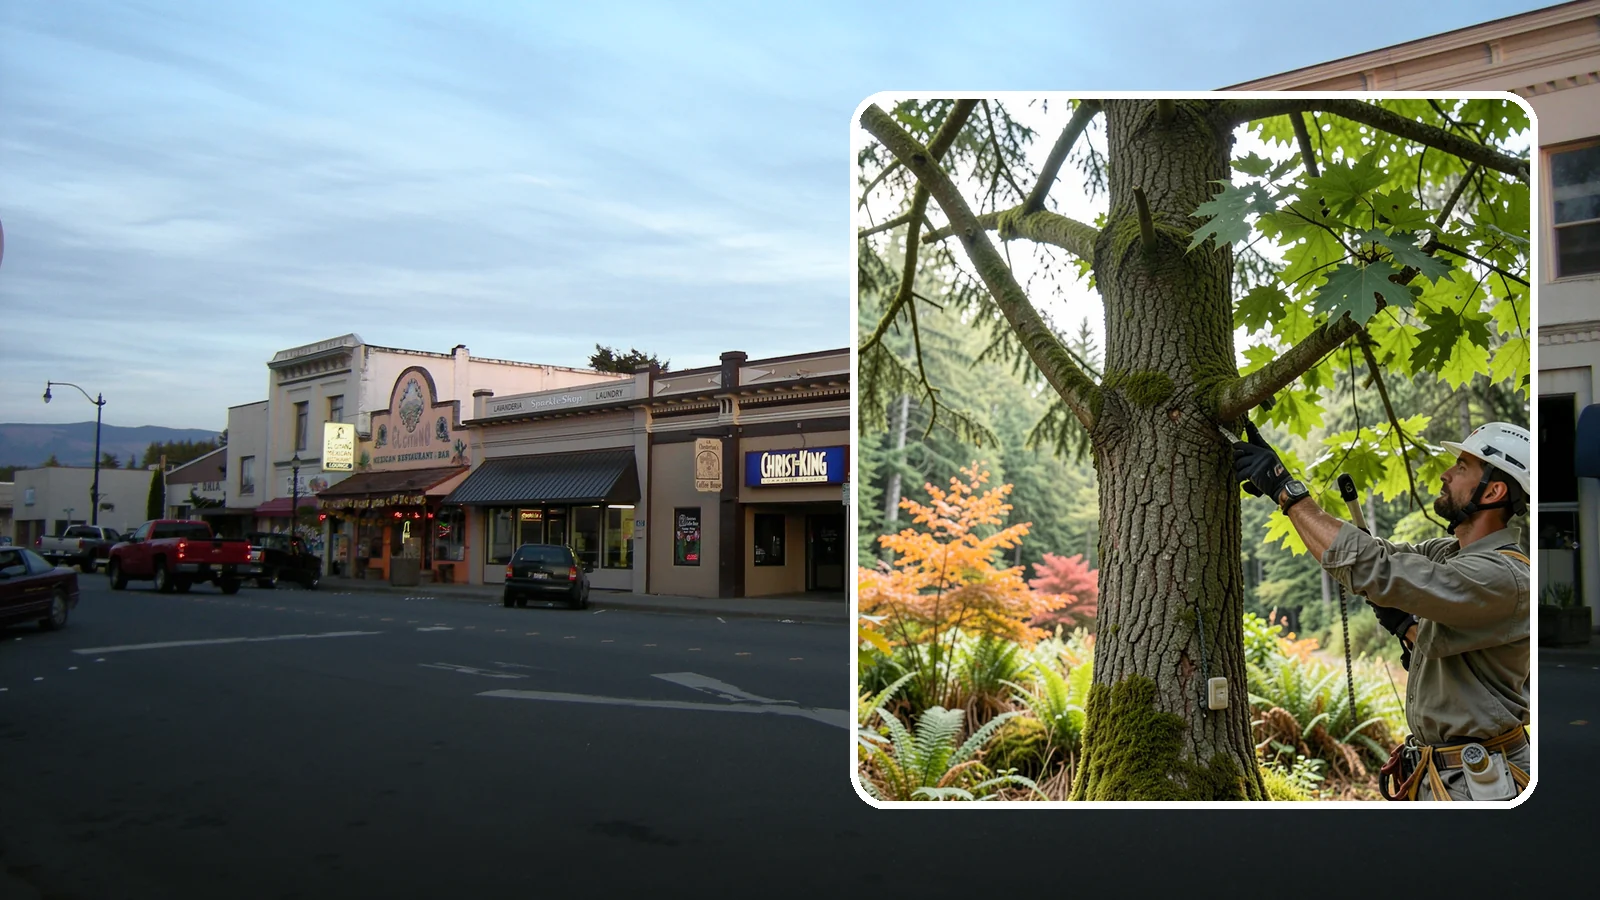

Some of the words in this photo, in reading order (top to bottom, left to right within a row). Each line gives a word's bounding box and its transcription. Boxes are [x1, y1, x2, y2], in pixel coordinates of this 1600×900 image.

[595, 389, 623, 399] LAUNDRY
[493, 402, 522, 412] LAVANDERIA
[530, 397, 560, 409] Sparkle
[560, 394, 583, 404] Shop
[373, 454, 396, 464] MEXICAN
[397, 451, 433, 462] RESTAURANT
[437, 450, 450, 459] BAR
[761, 452, 797, 478] CHRIST
[799, 450, 827, 476] KING
